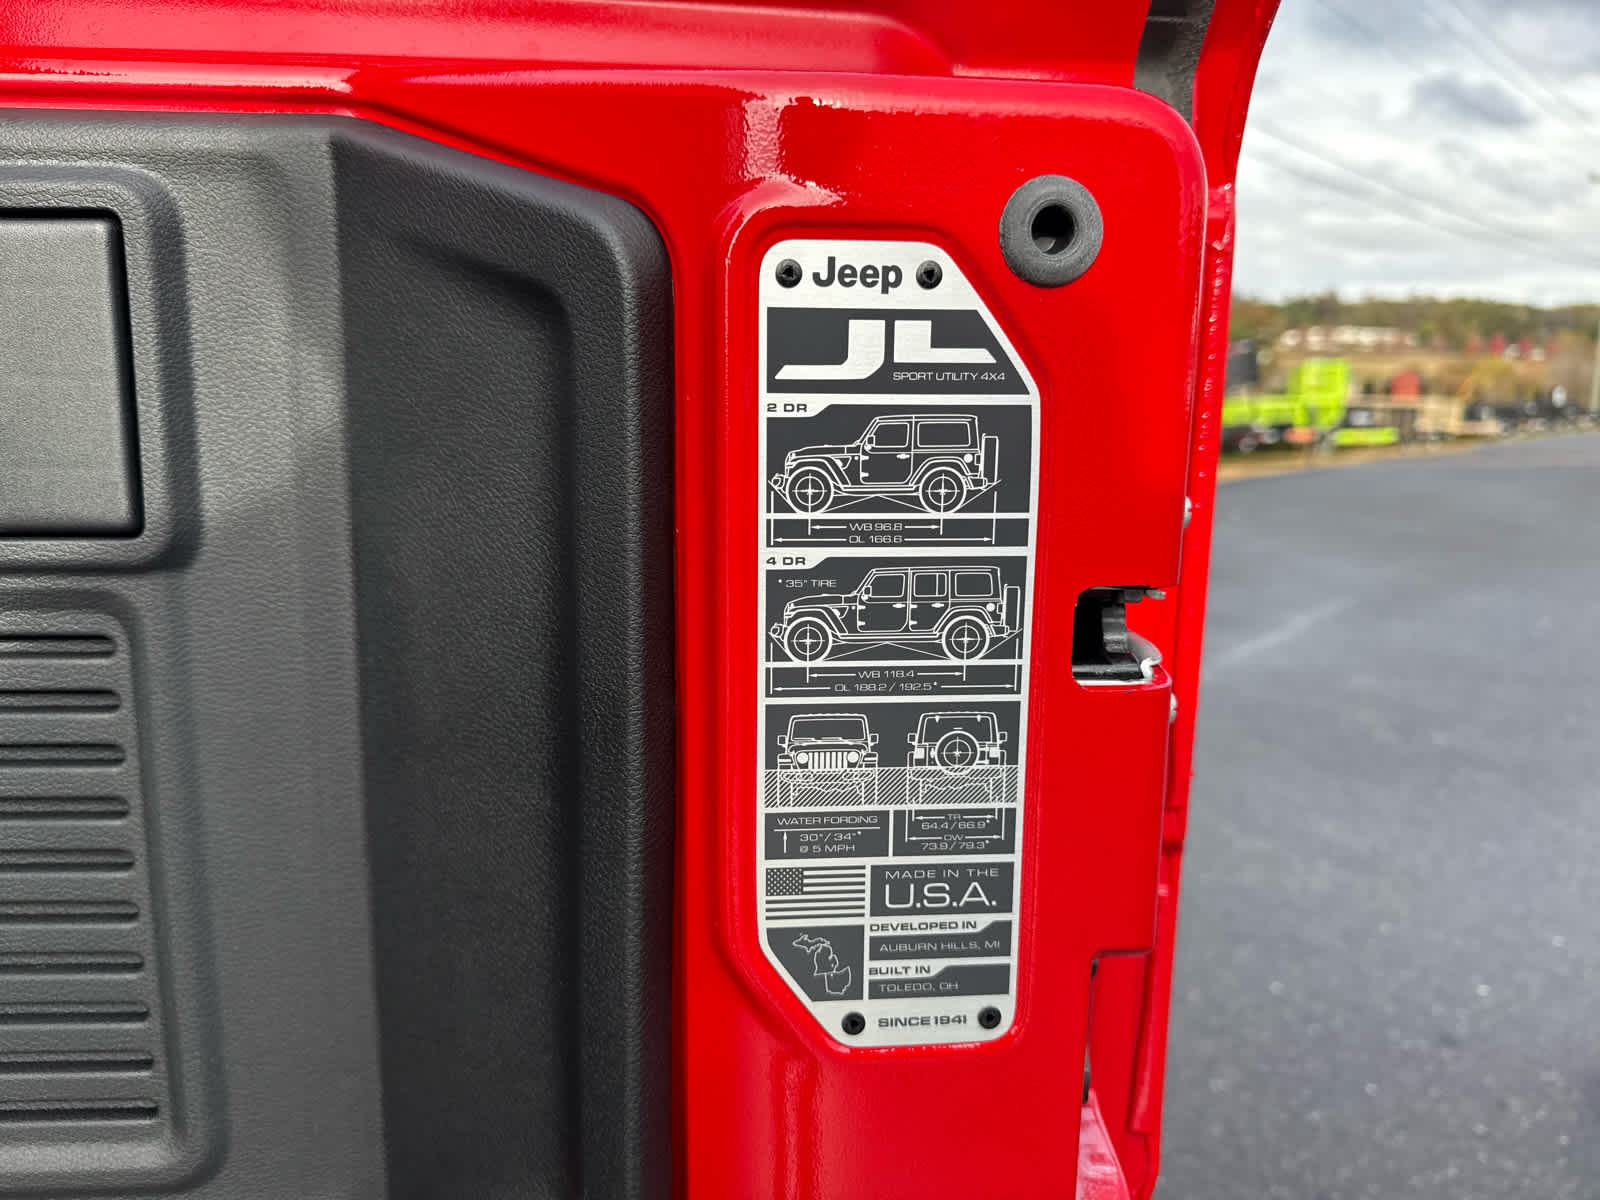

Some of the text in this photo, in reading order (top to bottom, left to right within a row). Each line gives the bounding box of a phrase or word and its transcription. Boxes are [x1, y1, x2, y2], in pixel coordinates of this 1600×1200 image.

[812, 256, 903, 294] Jeep
[774, 319, 997, 380] JL
[892, 371, 933, 381] SPORT
[935, 371, 979, 381] UTILITY
[766, 403, 808, 413] 2 DR
[849, 522, 903, 531] WB 96.8
[848, 535, 903, 544] OL 166.6
[766, 556, 806, 566] 4 DR
[810, 579, 837, 588] TIRE
[857, 670, 915, 679] WB 118.4
[776, 815, 878, 826] WATER FORDING
[812, 845, 822, 853] 5
[824, 844, 856, 853] MPH
[885, 867, 1000, 880] MADE IN THE
[884, 881, 998, 909] U.S.A.
[869, 920, 977, 932] DEVELOPED IN
[879, 940, 1000, 953] AUBURN HILLS, MI
[868, 965, 931, 976] BUILT IN
[879, 981, 959, 993] TOLEDO, OH
[877, 1014, 967, 1028] SINCE 1941
